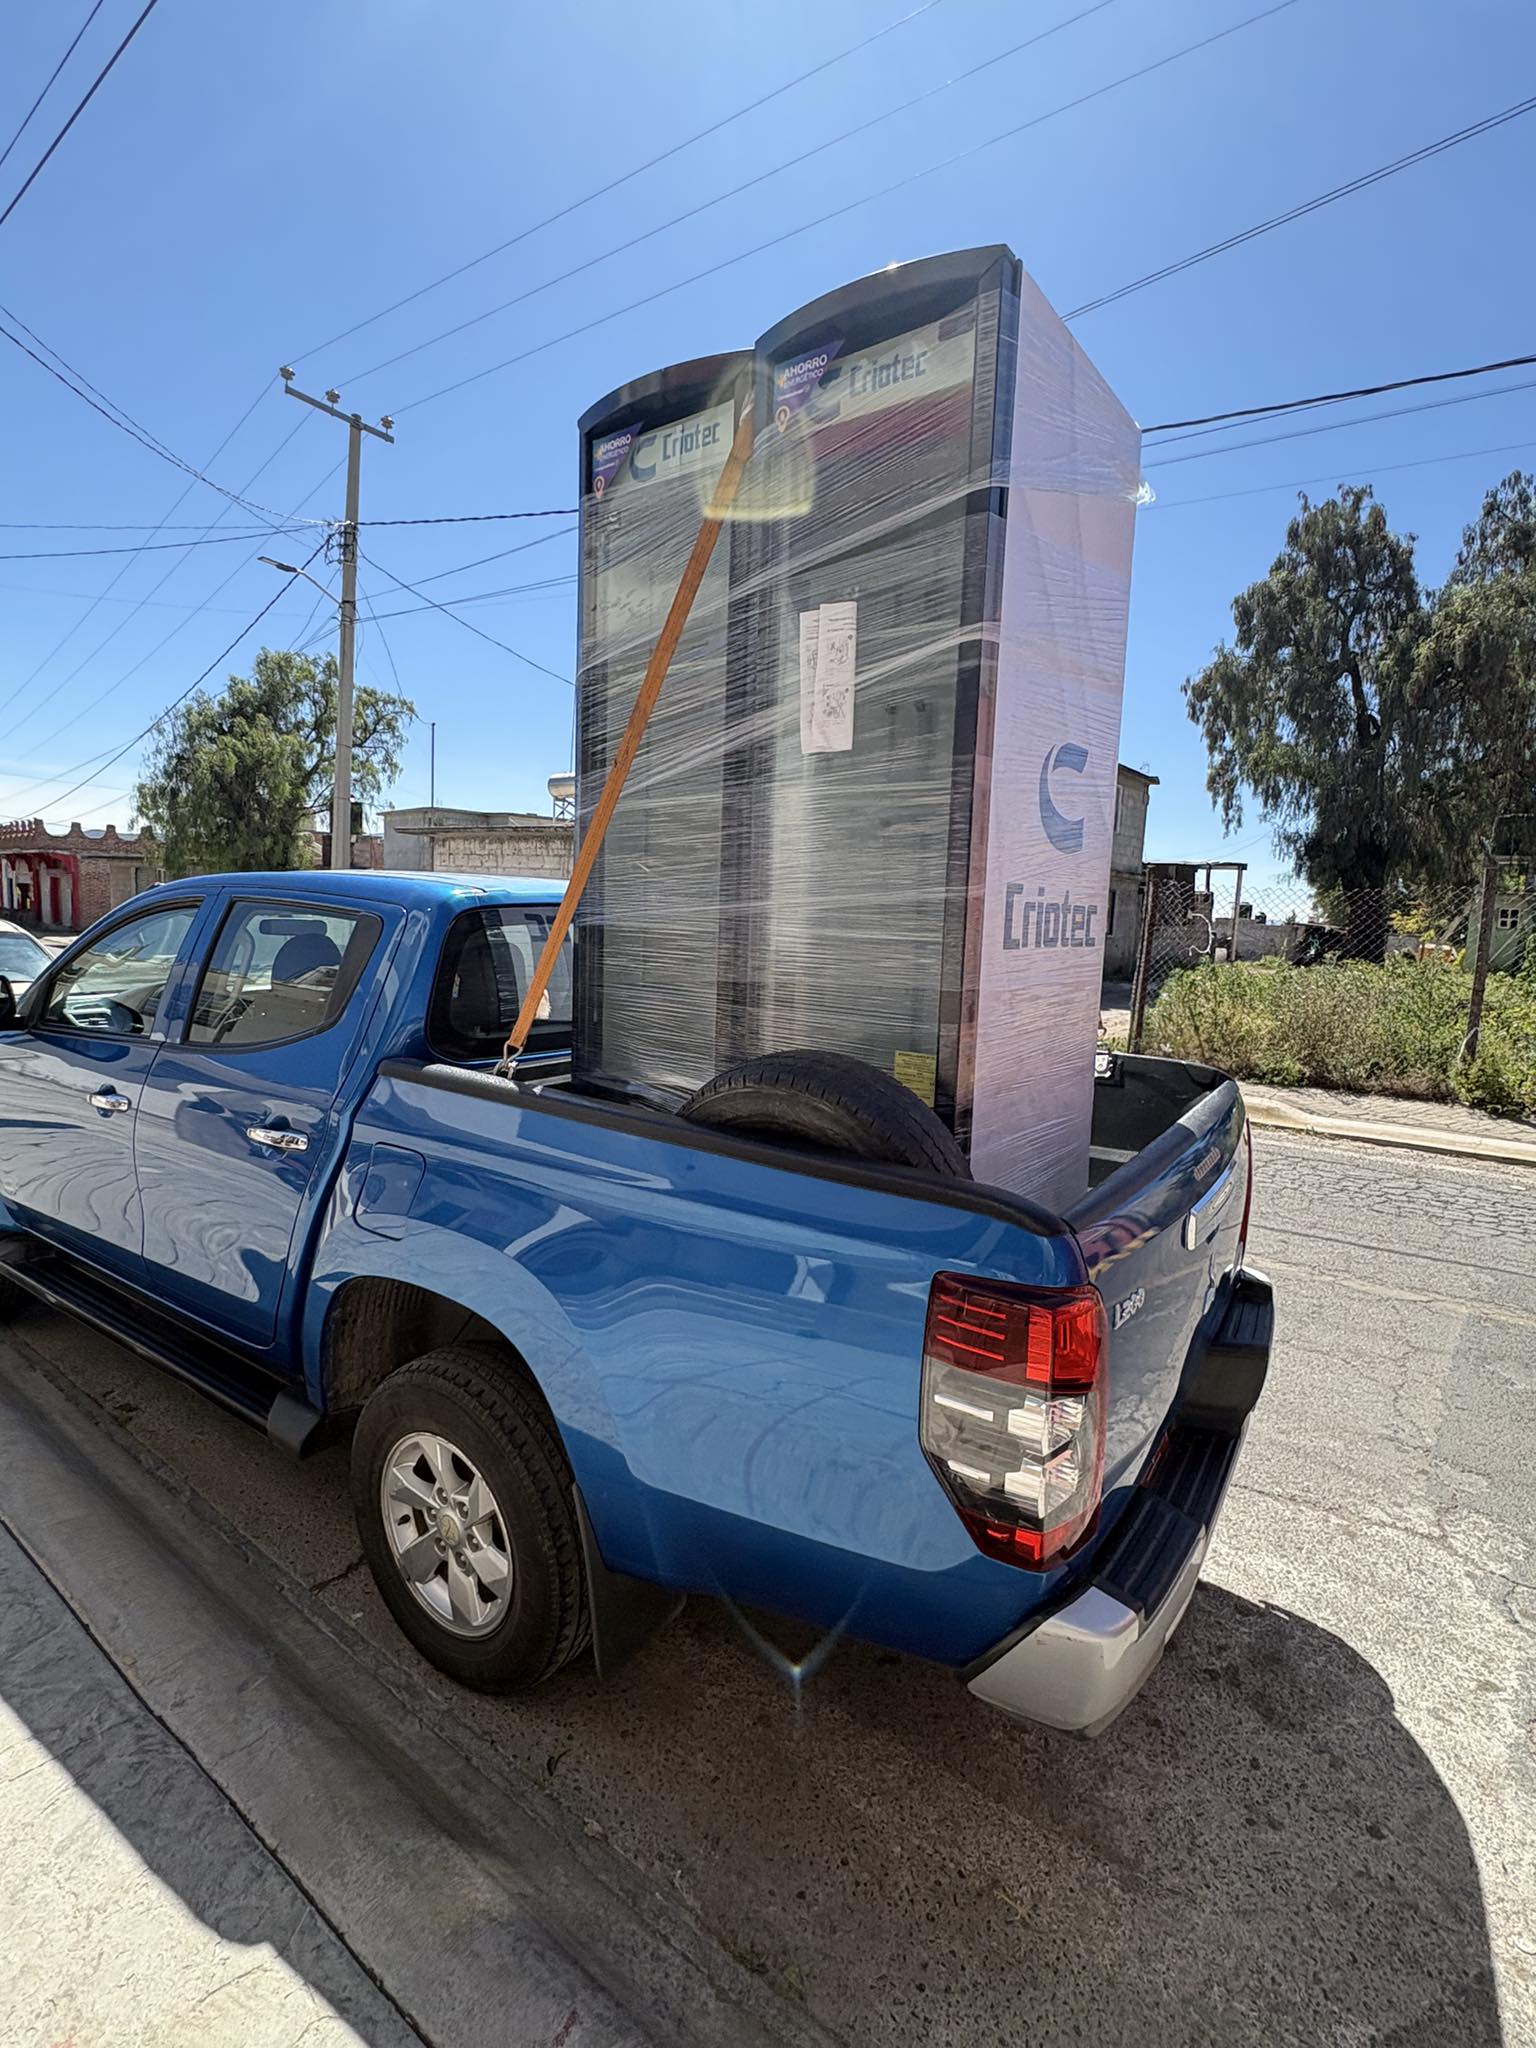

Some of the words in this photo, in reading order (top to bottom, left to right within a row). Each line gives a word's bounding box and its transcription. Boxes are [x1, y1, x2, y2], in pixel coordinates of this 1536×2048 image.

[784, 354, 828, 379] AHORRO
[848, 350, 928, 397] Criotec
[600, 434, 631, 452] AHORRO
[662, 422, 720, 461] Criotec
[1003, 882, 1098, 950] Criotec
